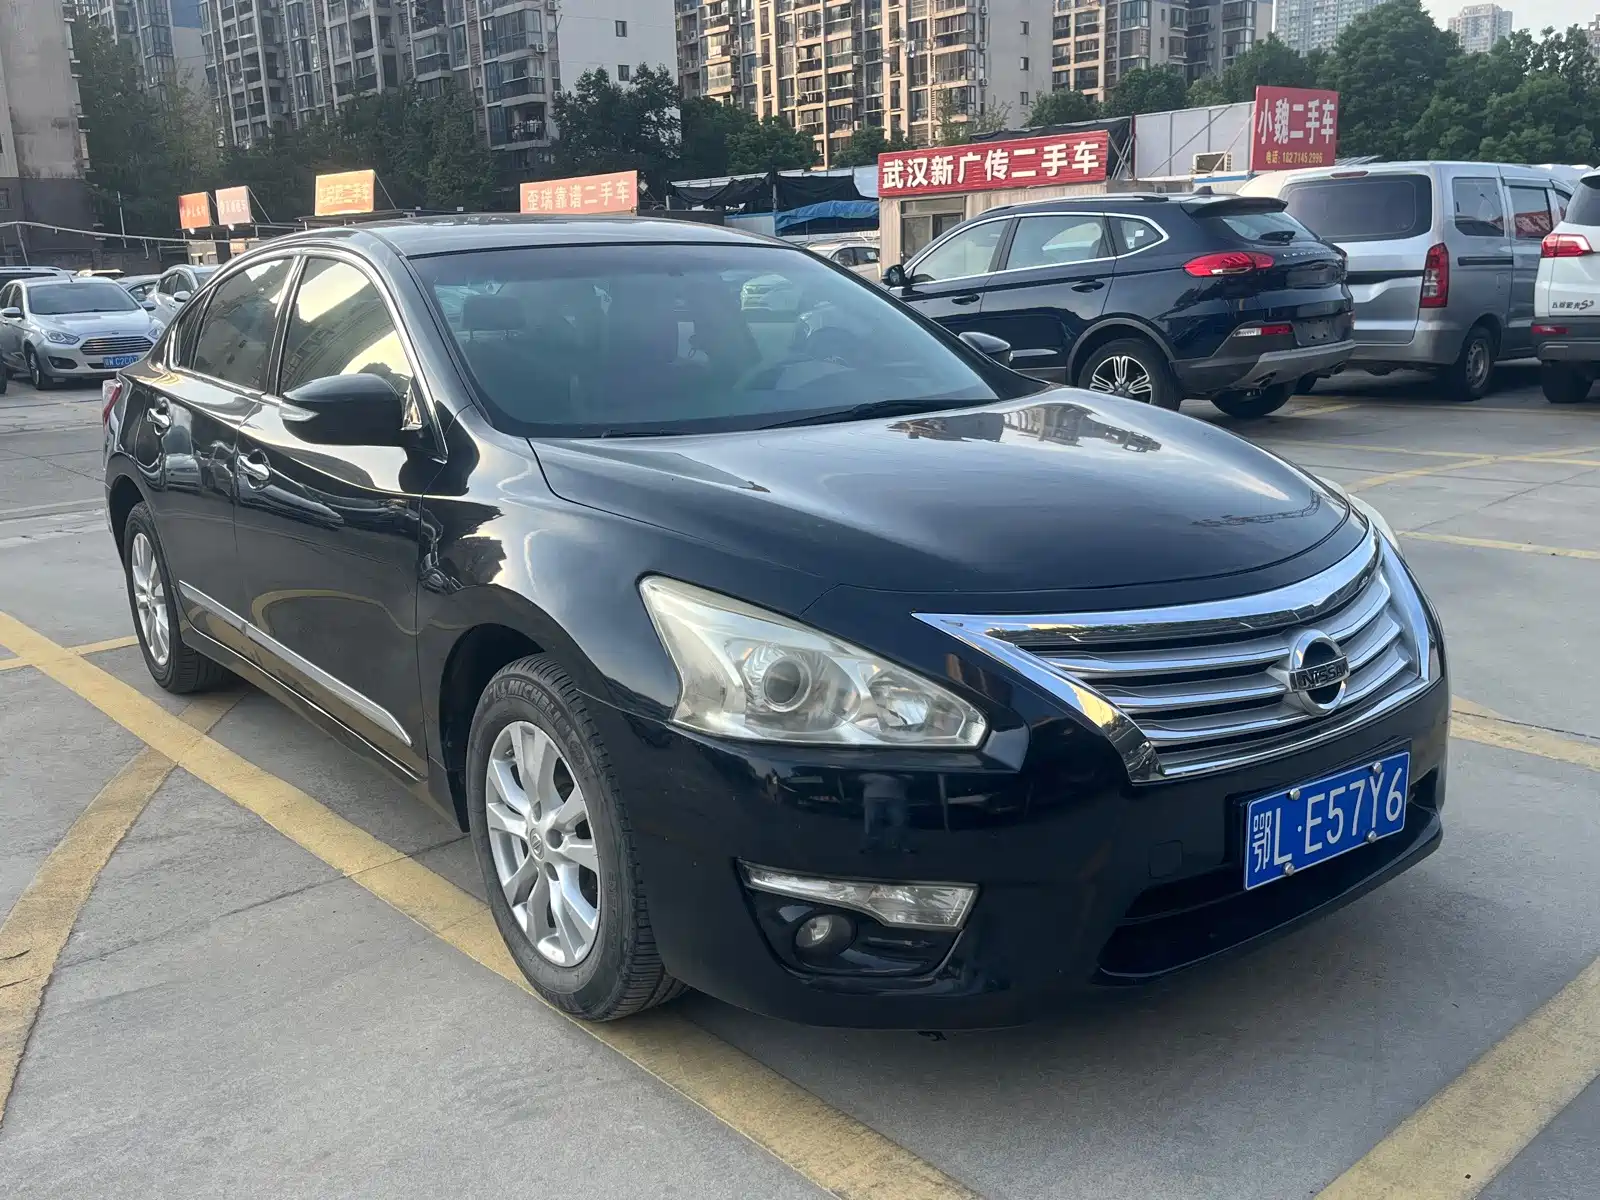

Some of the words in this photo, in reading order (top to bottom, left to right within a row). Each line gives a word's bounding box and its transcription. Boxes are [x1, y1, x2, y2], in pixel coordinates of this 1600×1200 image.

[1257, 98, 1335, 144] 小魏二手车
[882, 141, 1099, 189] 武汉新广传二手车
[527, 178, 630, 211] 歪瑞靠谱二手车
[1298, 661, 1349, 689] NISSAN
